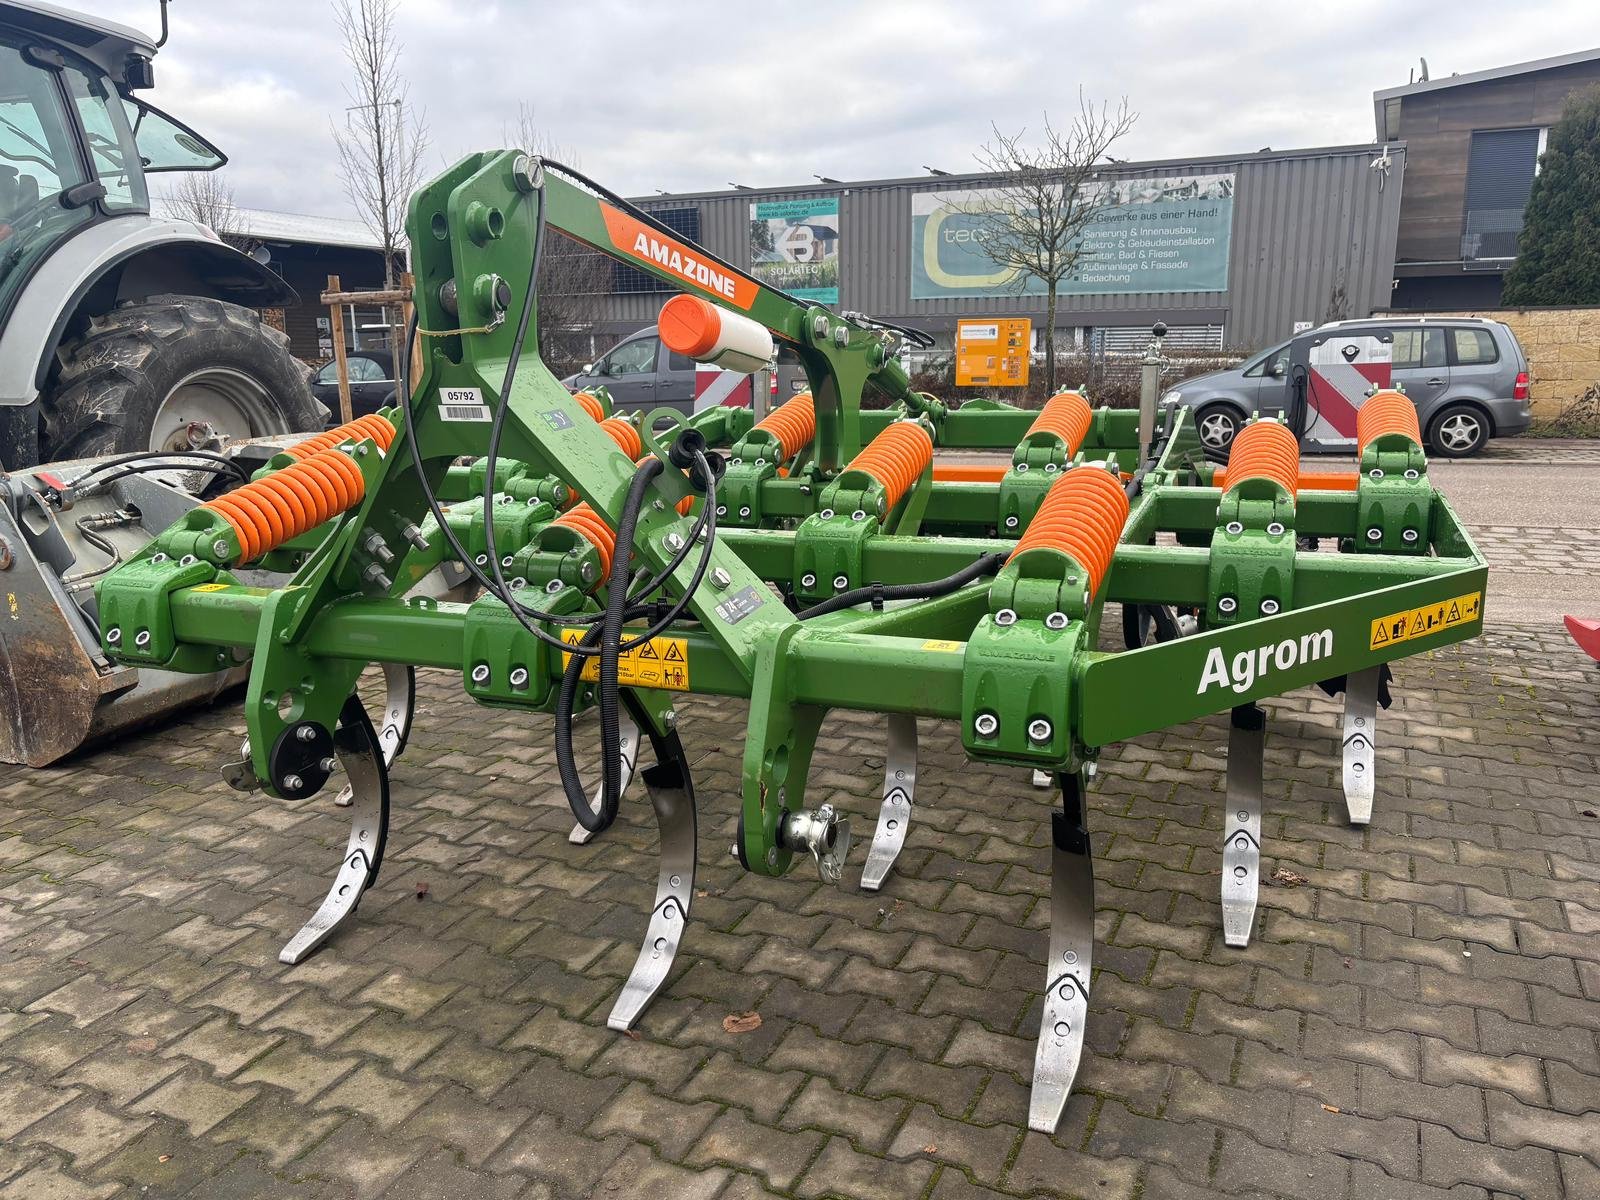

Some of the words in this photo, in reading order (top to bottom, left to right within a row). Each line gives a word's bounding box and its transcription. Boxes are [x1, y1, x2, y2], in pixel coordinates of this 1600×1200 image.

[1097, 211, 1137, 222] Gewerke
[1141, 212, 1157, 220] aus
[1161, 210, 1184, 219] einer
[1188, 207, 1218, 218] Hand!
[1084, 229, 1127, 239] Sanierung
[1130, 228, 1137, 236] &
[1141, 227, 1197, 236] Innenausbau
[1118, 239, 1125, 248] &
[1119, 250, 1135, 259] Bad
[1138, 250, 1146, 258] &
[1149, 249, 1179, 258] Fliesen
[633, 232, 735, 298] AMAZONE
[1083, 262, 1138, 272] Außenanlage
[1141, 261, 1148, 270] &
[1151, 260, 1188, 269] Fassade
[1082, 273, 1130, 283] Bedachung
[447, 391, 475, 401] 05792
[1197, 628, 1333, 694] Agrom
